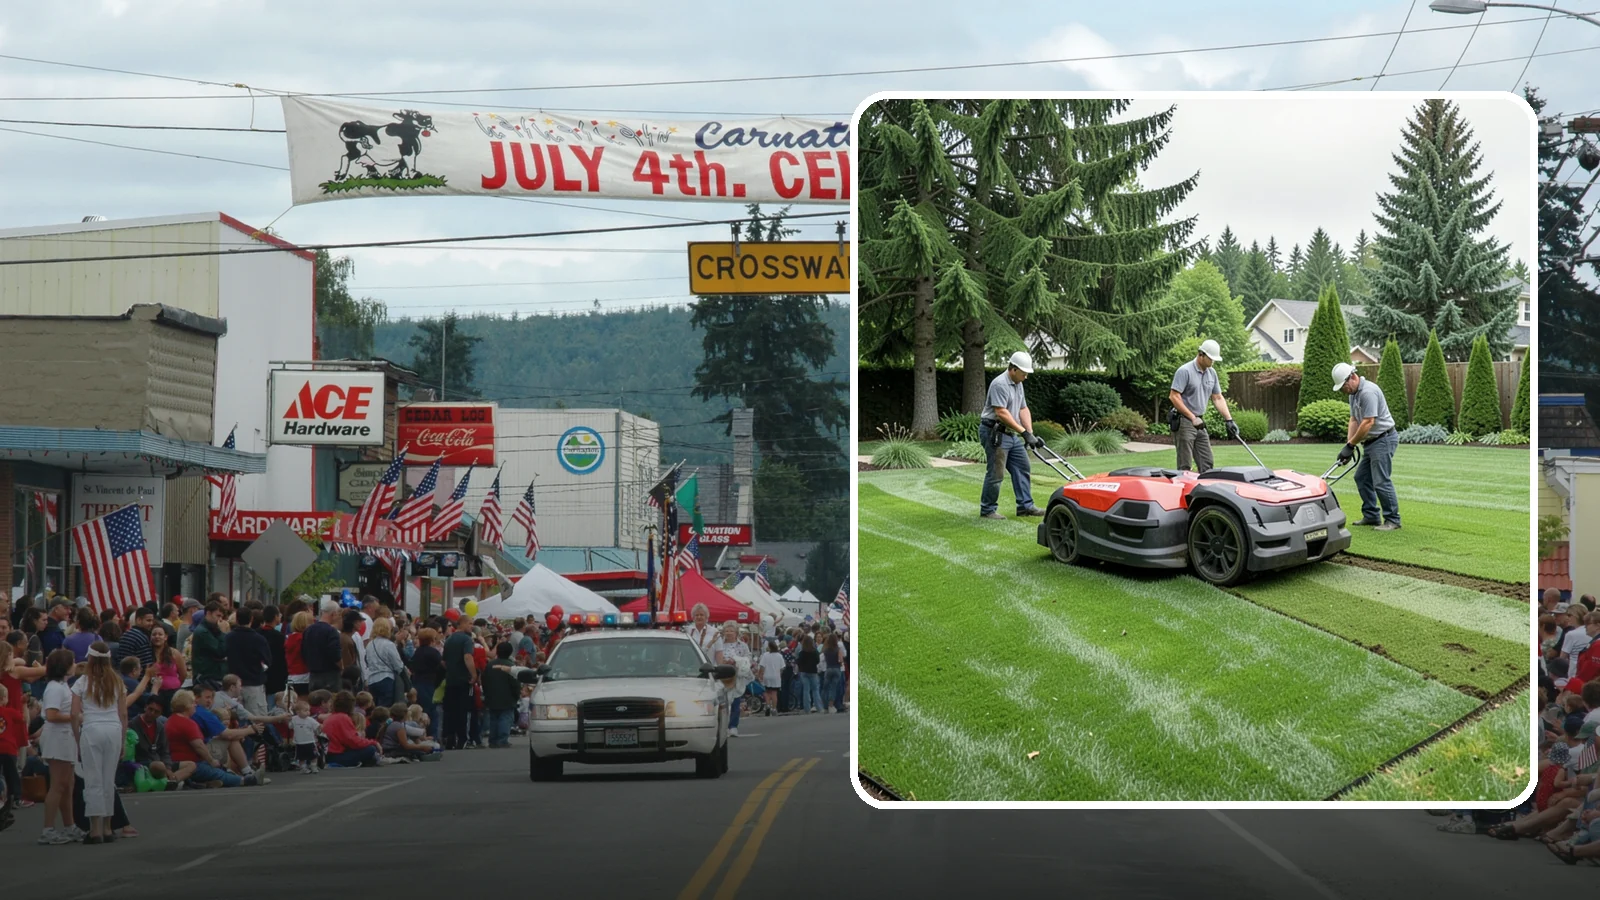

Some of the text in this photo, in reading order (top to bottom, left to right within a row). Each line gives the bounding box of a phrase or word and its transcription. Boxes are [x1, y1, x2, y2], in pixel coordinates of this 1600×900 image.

[481, 141, 604, 192] JULY
[632, 150, 746, 197] 4th.
[697, 255, 850, 279] CROSSWA
[283, 380, 373, 420] ACE
[406, 409, 453, 422] CEDAR
[283, 421, 371, 436] Hardware
[96, 485, 125, 494] Vincent
[126, 486, 136, 495] de
[137, 486, 155, 495] Paul
[688, 526, 741, 535] CRNATION
[699, 535, 730, 543] GLASS
